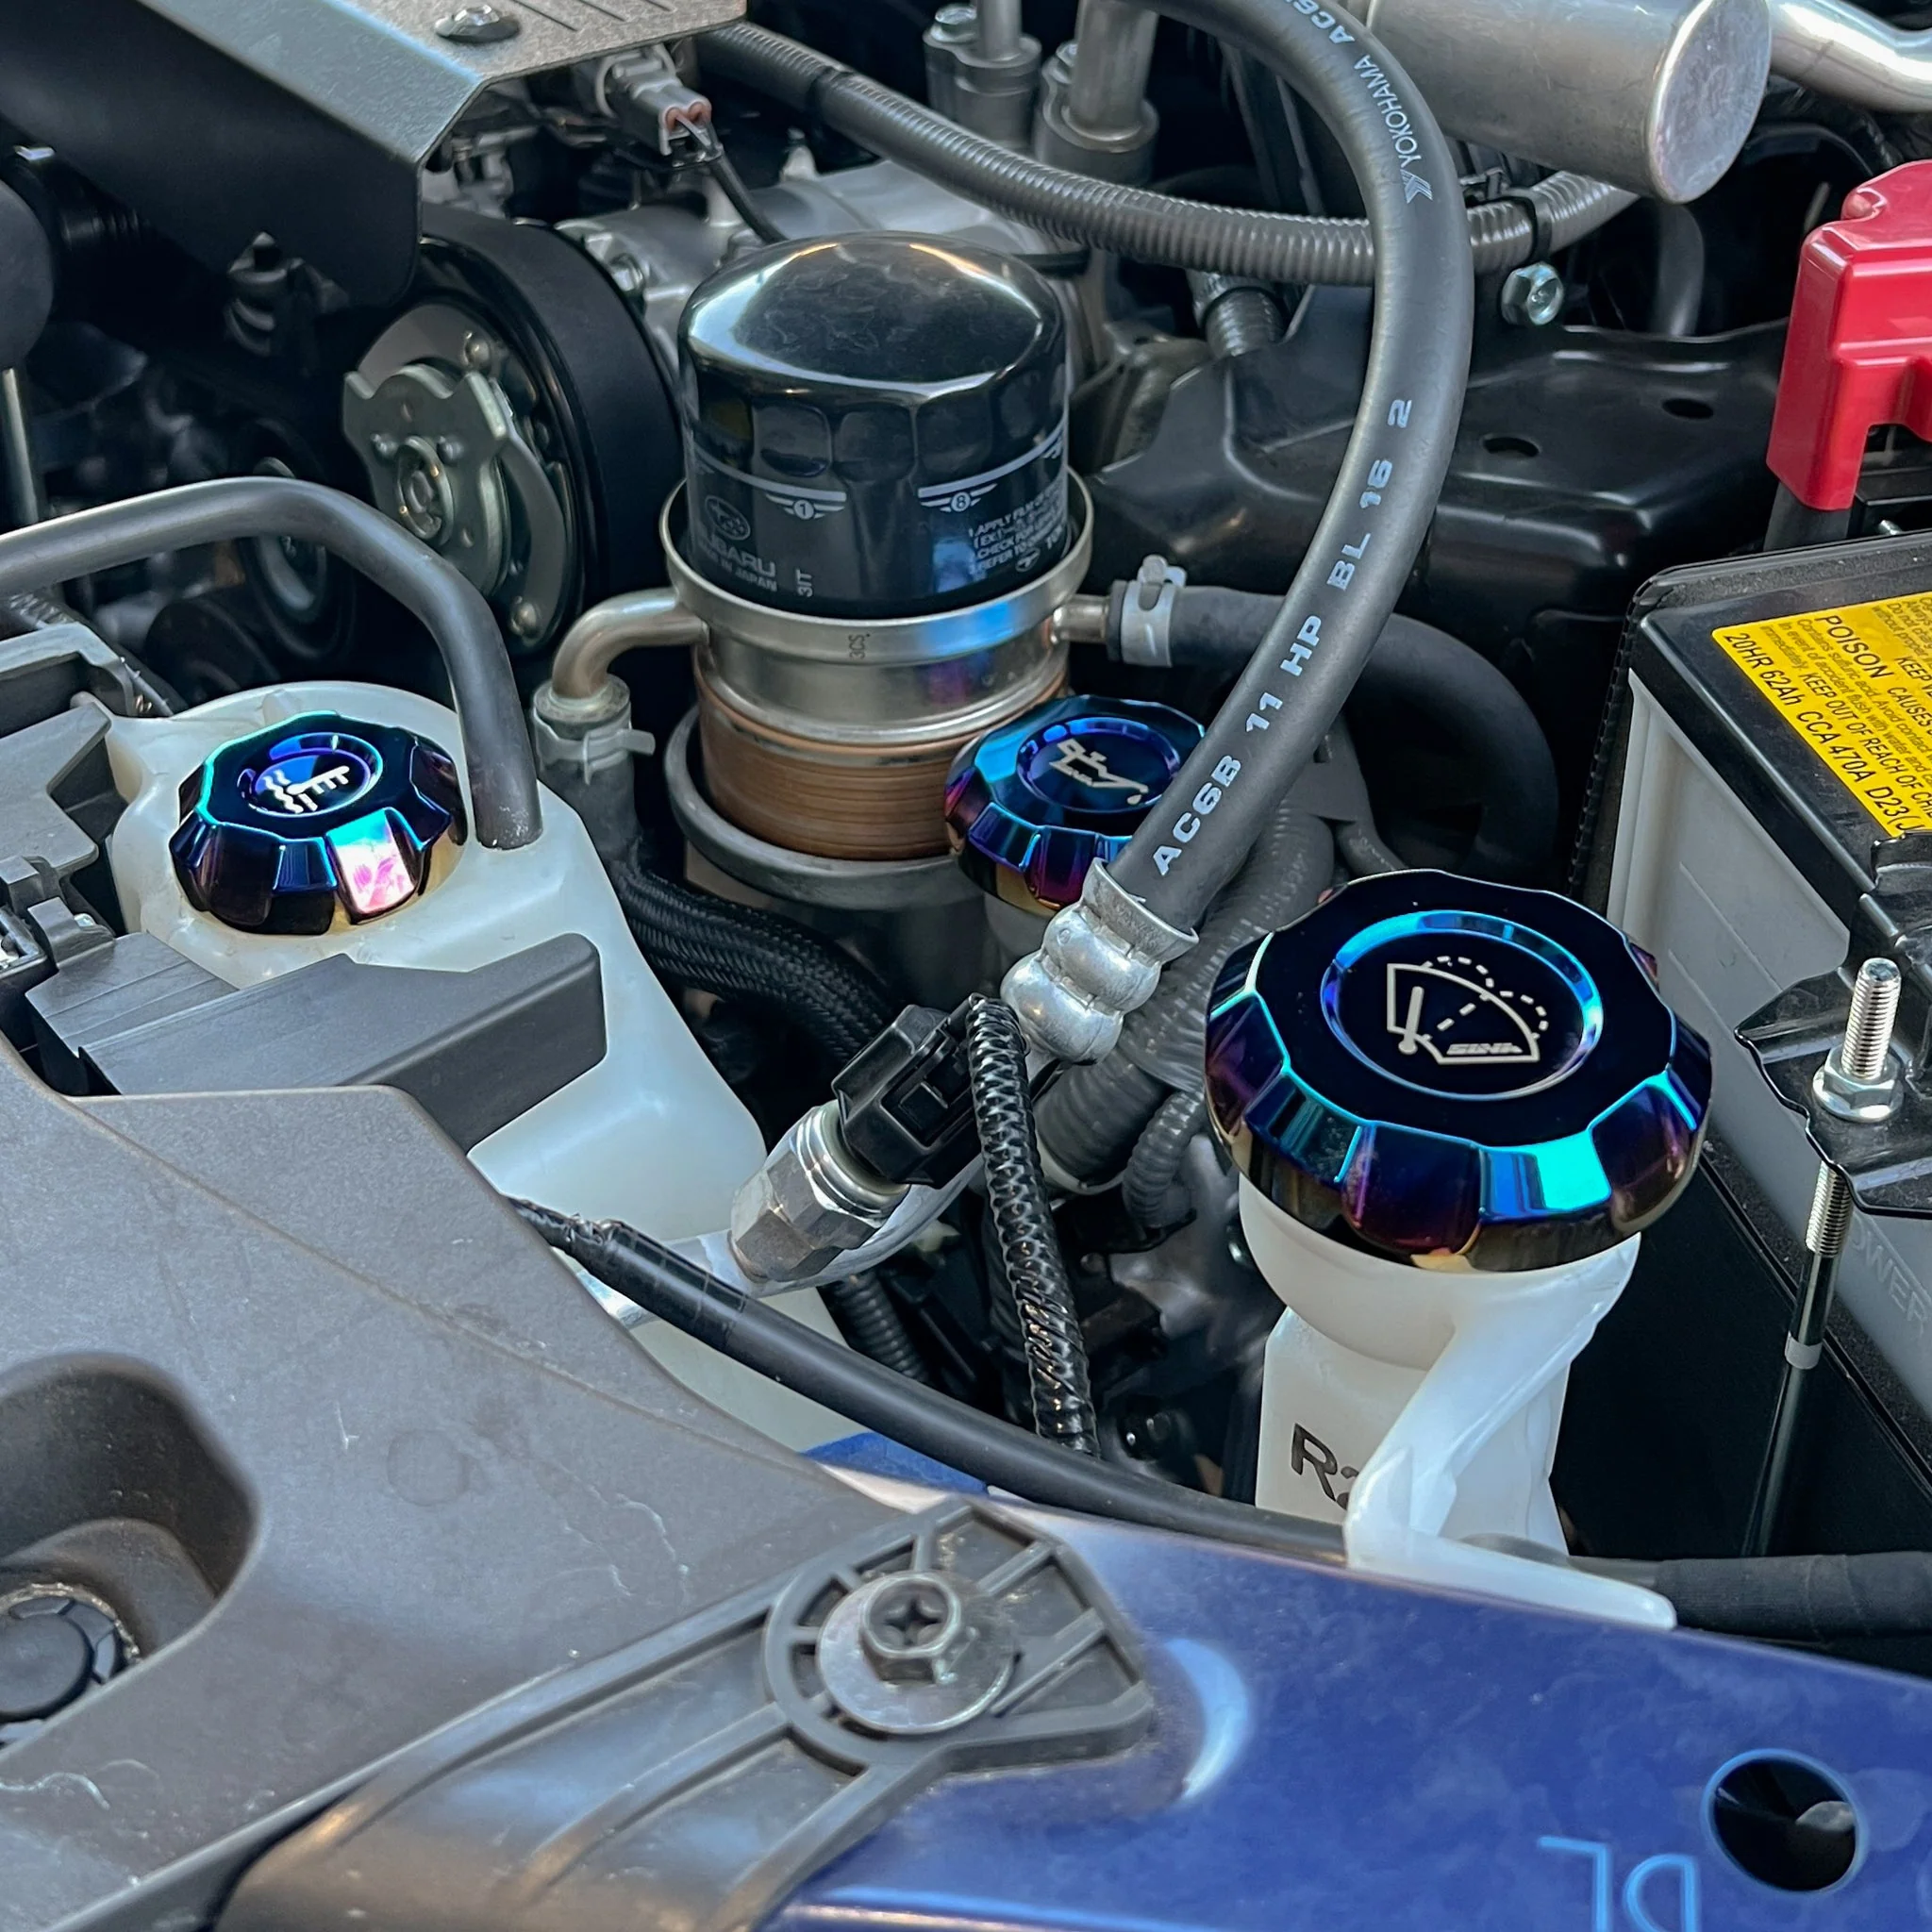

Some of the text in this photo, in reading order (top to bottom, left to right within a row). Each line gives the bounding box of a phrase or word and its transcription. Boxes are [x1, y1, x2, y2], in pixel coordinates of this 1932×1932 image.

[1286, 0, 1422, 167] YOKOHAMA AC6
[1152, 398, 1412, 875] AC6B 11 HP BL 16 2
[1799, 673, 1838, 698] KEEP
[1814, 615, 1932, 726] POISON CAUSES
[1894, 657, 1932, 681] KEEP
[1724, 633, 1774, 669] 20HR
[1759, 671, 1805, 706] 62Ah
[1796, 711, 1841, 744] CCA
[1828, 746, 1876, 782] 470A
[1825, 700, 1859, 720] OUT
[1845, 723, 1874, 735] OF
[1859, 738, 1908, 774] REACH
[1895, 775, 1924, 789] OF
[1851, 1212, 1928, 1336] OWER
